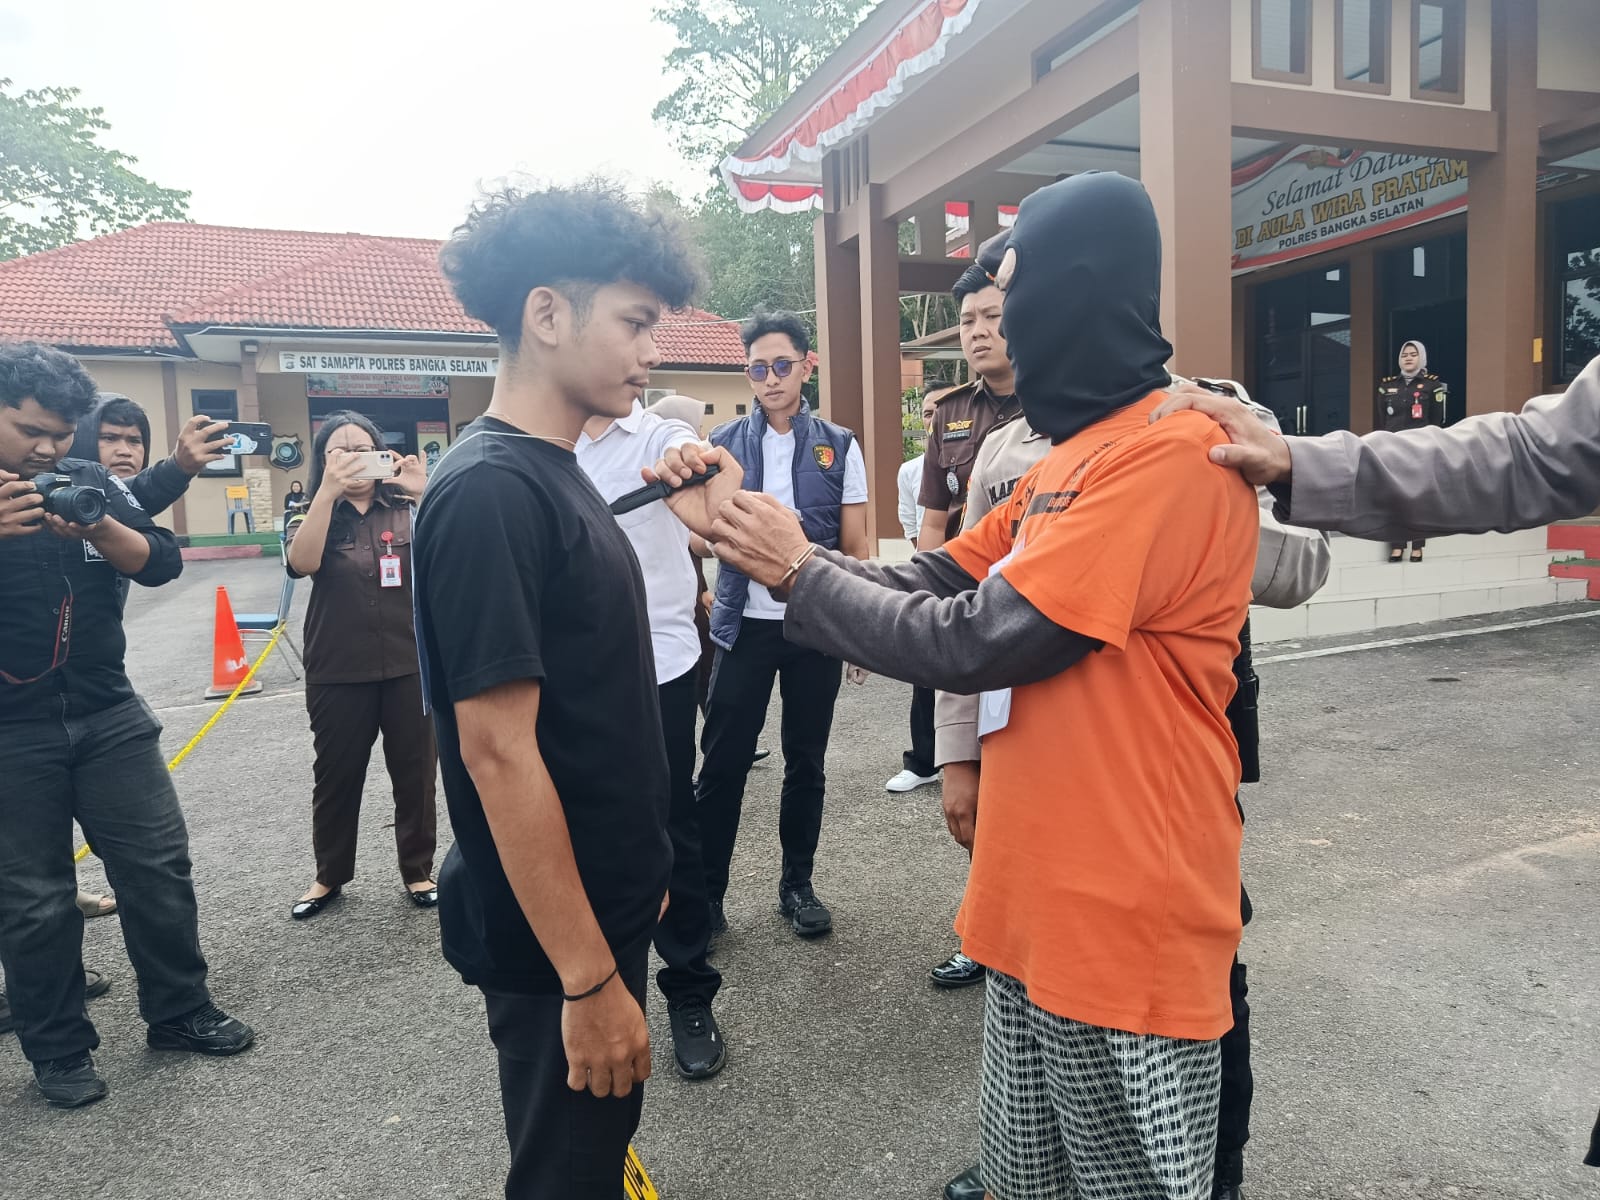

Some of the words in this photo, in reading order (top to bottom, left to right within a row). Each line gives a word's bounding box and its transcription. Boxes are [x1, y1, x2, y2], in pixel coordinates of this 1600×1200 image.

[1262, 169, 1344, 216] Selamat
[1350, 152, 1444, 182] Data
[1235, 225, 1254, 250] DI
[1256, 208, 1306, 243] AULA
[1311, 188, 1366, 225] WIRA
[1279, 229, 1318, 249] POLRES
[1320, 214, 1367, 237] BANGKA
[1370, 197, 1424, 222] SELATAN
[300, 355, 317, 369] SAT
[321, 356, 366, 370] SAMAPTA
[369, 357, 406, 371] POLRES
[409, 358, 447, 372] BANGKA
[450, 360, 488, 373] SELATAN
[61, 605, 70, 642] Canon
